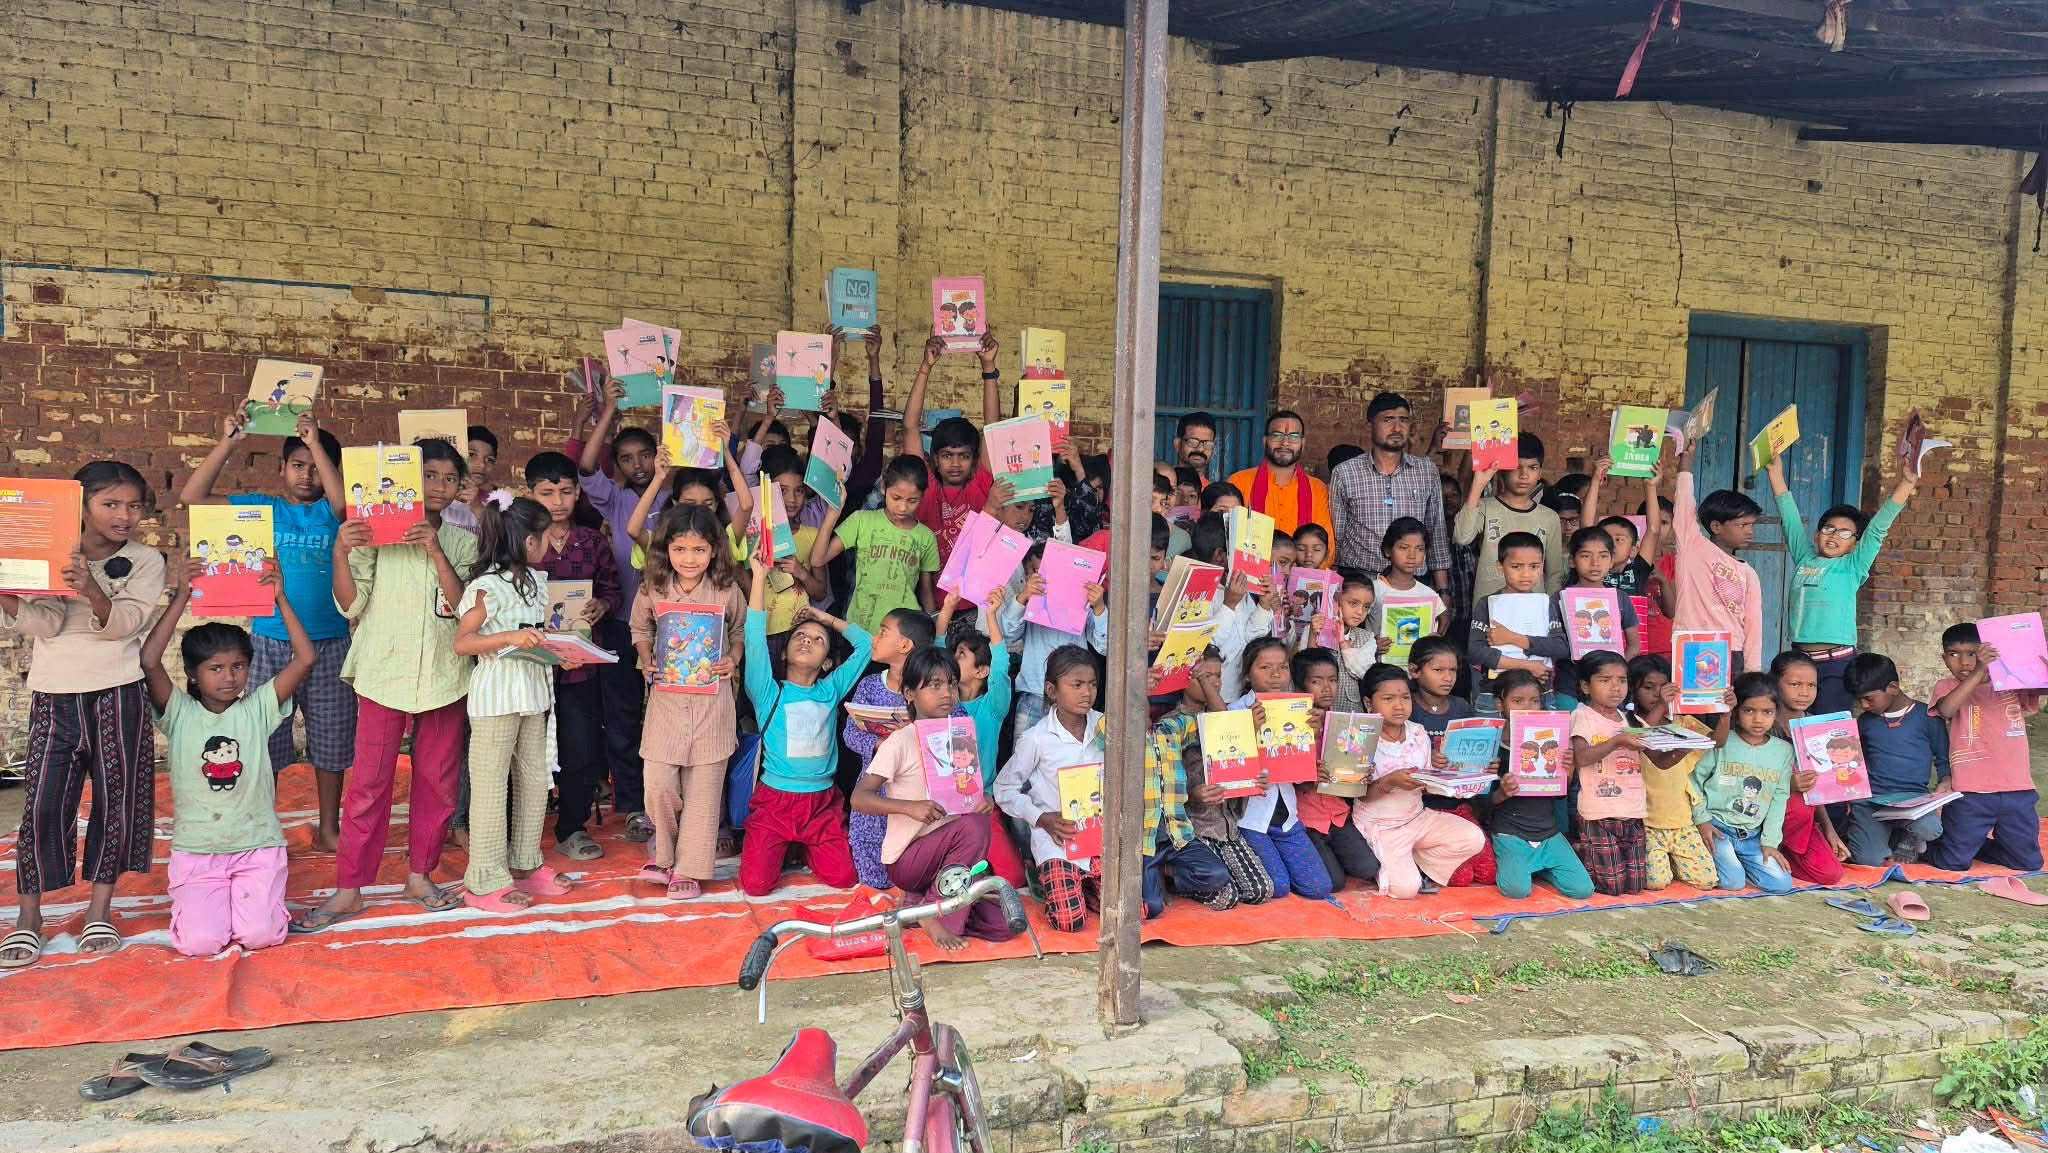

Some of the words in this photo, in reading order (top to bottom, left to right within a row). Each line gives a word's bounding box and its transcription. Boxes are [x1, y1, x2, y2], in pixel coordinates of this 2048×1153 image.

[846, 280, 869, 297] NO
[1006, 454, 1023, 464] LIFE
[1623, 452, 1650, 461] INDIA
[870, 544, 888, 559] CUT
[1460, 740, 1488, 756] NO
[1720, 761, 1780, 784] URBAN
